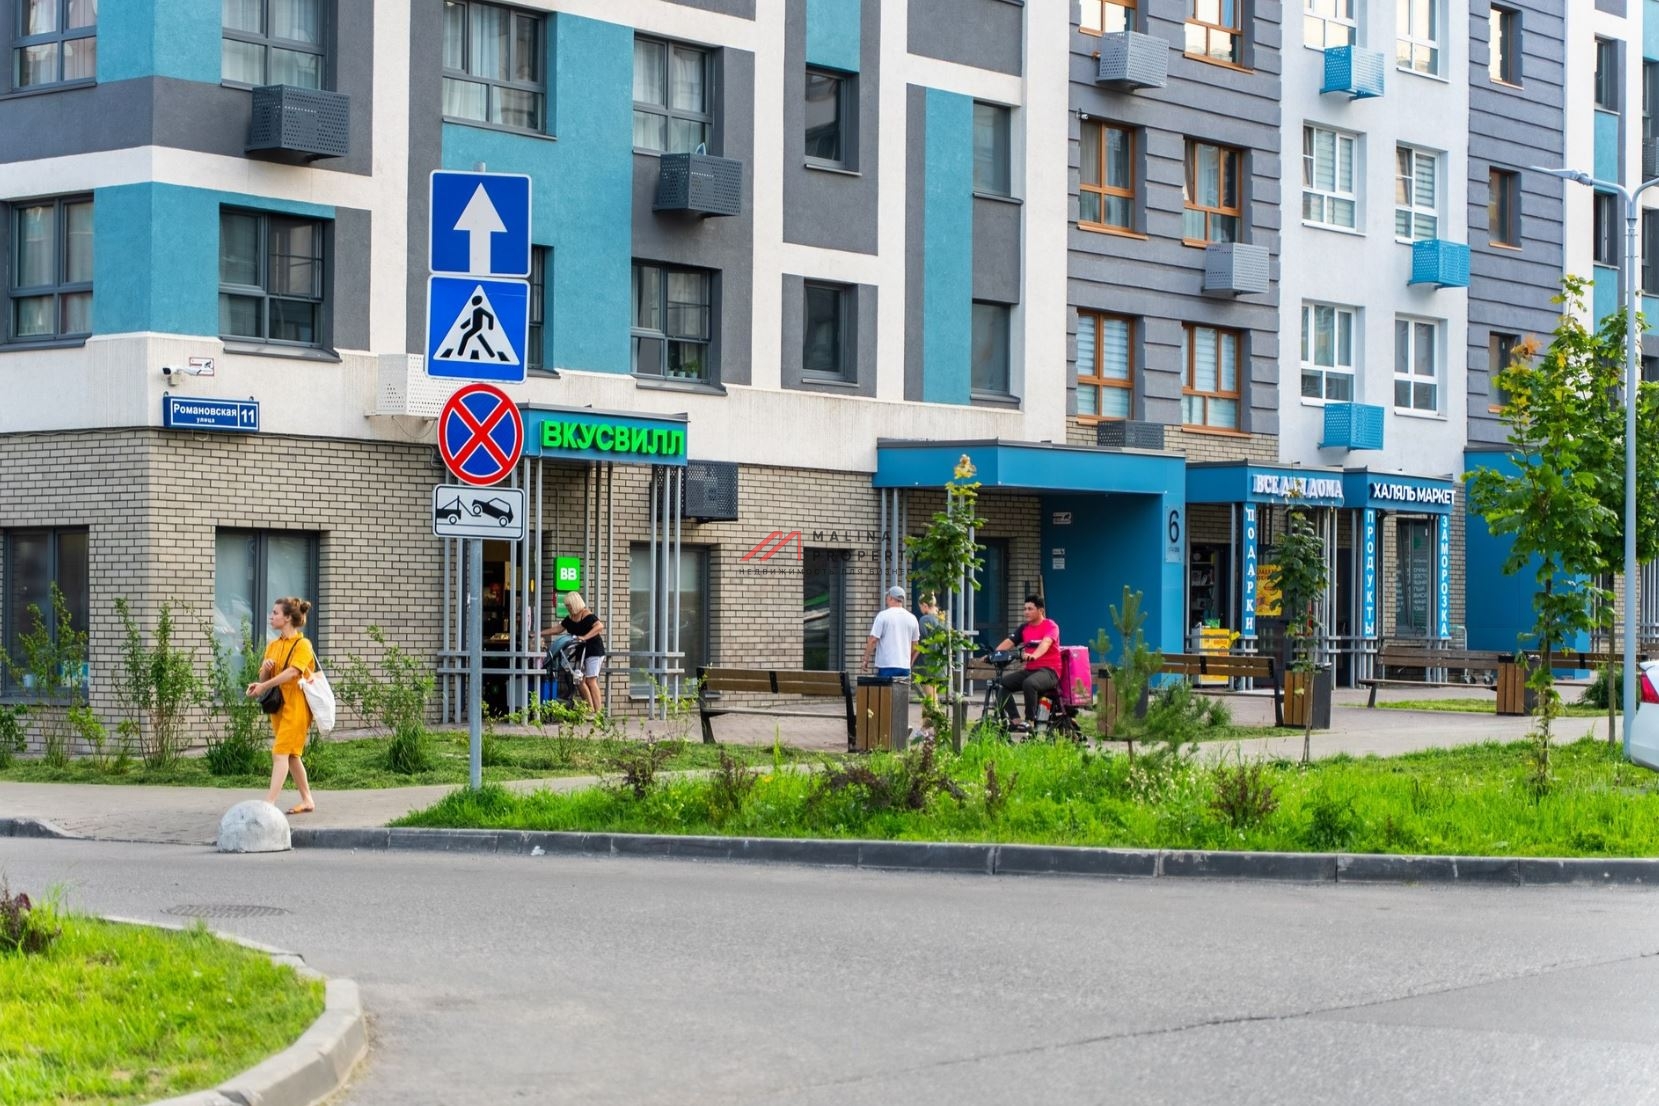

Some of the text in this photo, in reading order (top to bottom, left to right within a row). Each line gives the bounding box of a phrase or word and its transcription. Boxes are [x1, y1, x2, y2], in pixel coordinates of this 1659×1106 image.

[173, 403, 237, 417] Романовская
[241, 409, 254, 423] 11
[541, 420, 685, 456] ВКУСВИЛЛ
[1253, 474, 1279, 494] ВСЕ
[1306, 478, 1343, 498] ДОМА
[1373, 483, 1457, 505] ХАЛЯЛЬ МАРКЕТ
[1169, 510, 1179, 543] 6
[1245, 507, 1256, 630] ПОДАРКИ
[1365, 511, 1375, 635] ПРОДУКТЫ
[1440, 515, 1449, 635] ЗАМОРОЗКА
